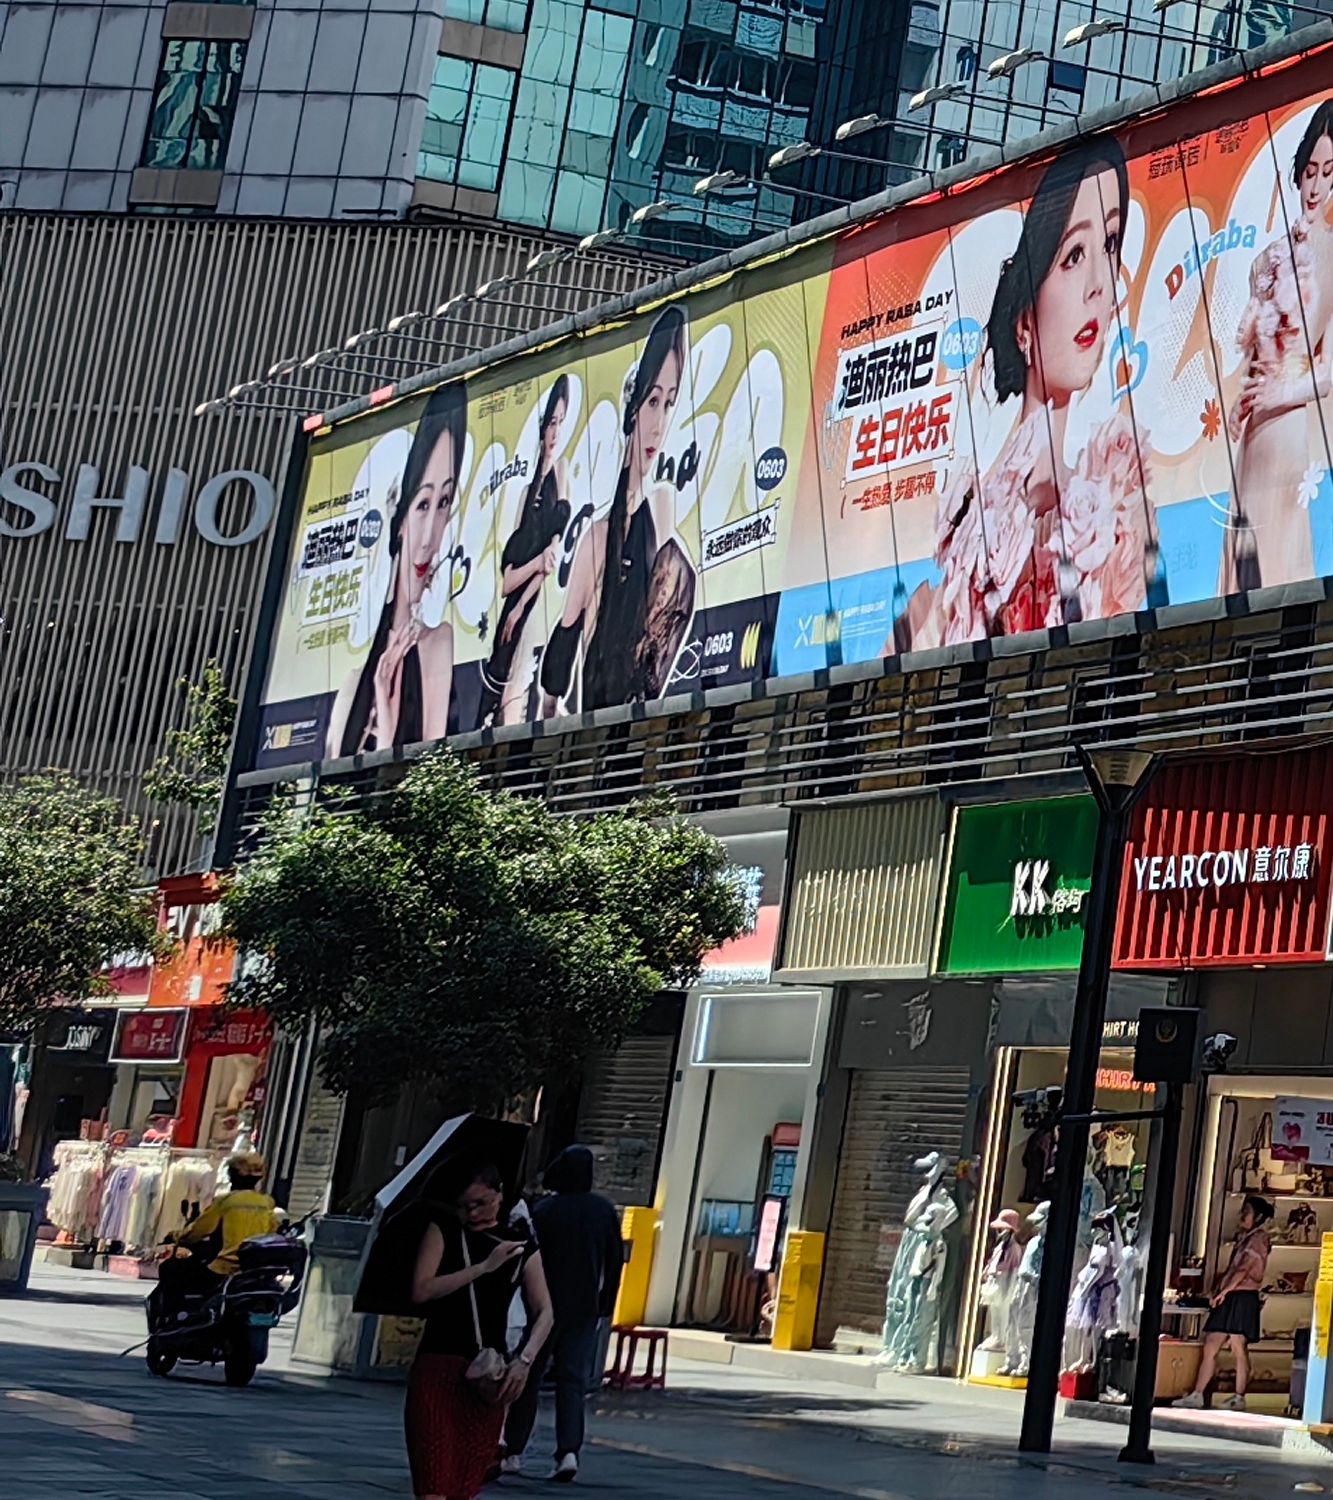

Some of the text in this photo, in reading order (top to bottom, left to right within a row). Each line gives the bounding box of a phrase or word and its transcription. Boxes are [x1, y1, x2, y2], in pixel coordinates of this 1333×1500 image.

[841, 290, 954, 340] HAPPY RABA DAY
[838, 331, 938, 411] 迪丽热巴
[943, 332, 979, 356] 0603
[852, 392, 952, 471] 生日快乐
[757, 457, 784, 479] 0603
[0, 461, 277, 546] SHIO
[1010, 858, 1052, 916] KK
[1134, 842, 1312, 891] YEARCON 意尔康
